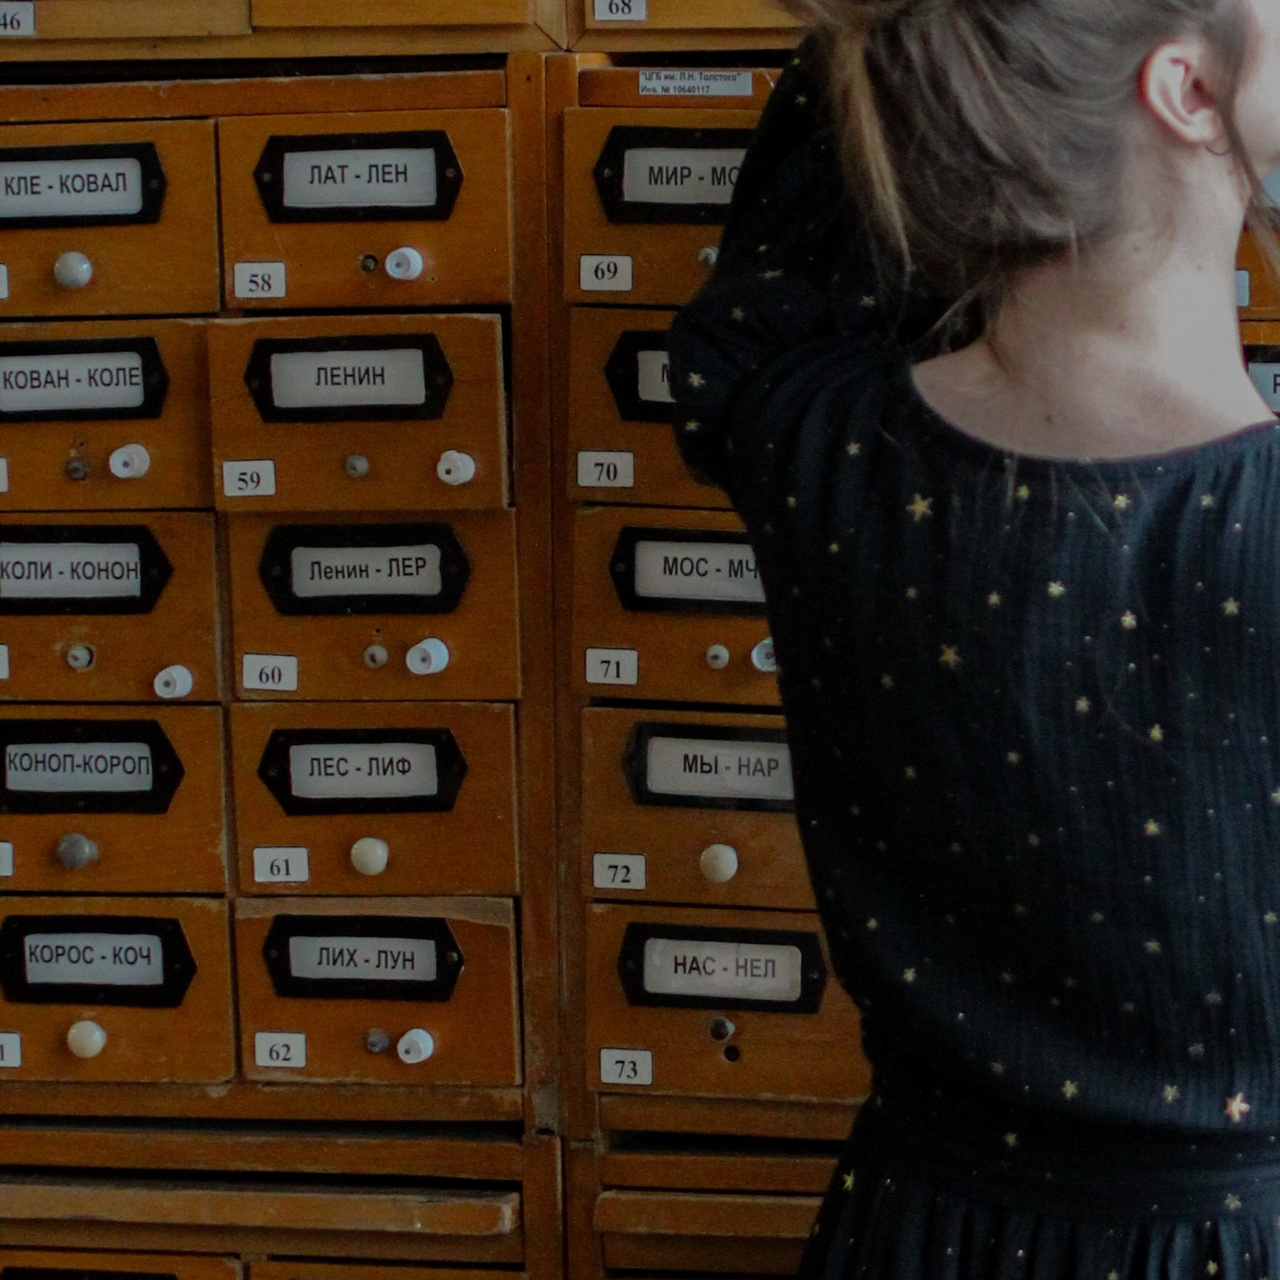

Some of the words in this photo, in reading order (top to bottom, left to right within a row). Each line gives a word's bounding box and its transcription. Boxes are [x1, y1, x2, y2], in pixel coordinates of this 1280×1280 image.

[310, 165, 348, 184] ЛАТ
[367, 164, 407, 183] ЛЕН
[649, 166, 691, 185] МИР
[5, 176, 41, 195] КЛЕ
[60, 172, 126, 193] КОВАЛ
[594, 263, 618, 279] 69
[249, 274, 271, 292] 58
[3, 370, 69, 389] КОВАН
[89, 367, 140, 386] КОЛЕ
[316, 367, 384, 385] ЛЕНИН
[595, 463, 617, 480] 70
[238, 472, 260, 490] 59
[0, 561, 51, 580] КОЛИ
[71, 562, 138, 580] КОНОН
[310, 561, 369, 580] Ленин
[388, 557, 426, 577] ЛЕР
[259, 668, 282, 682] 60
[601, 660, 620, 678] 71
[309, 757, 348, 776] ЛЕС
[368, 757, 411, 776] ЛИФ
[684, 754, 718, 774] МЫ
[738, 758, 779, 777] НАР
[270, 859, 290, 876] 61
[608, 865, 630, 883] 72
[29, 945, 93, 964] КОРОС
[113, 946, 151, 965] КОЧ
[318, 947, 357, 967] ЛИХ
[376, 950, 414, 970] ЛУН
[674, 956, 716, 974] НАС
[736, 958, 775, 978] НЕЛ
[269, 1044, 291, 1061] 62
[615, 1060, 637, 1078] 73
